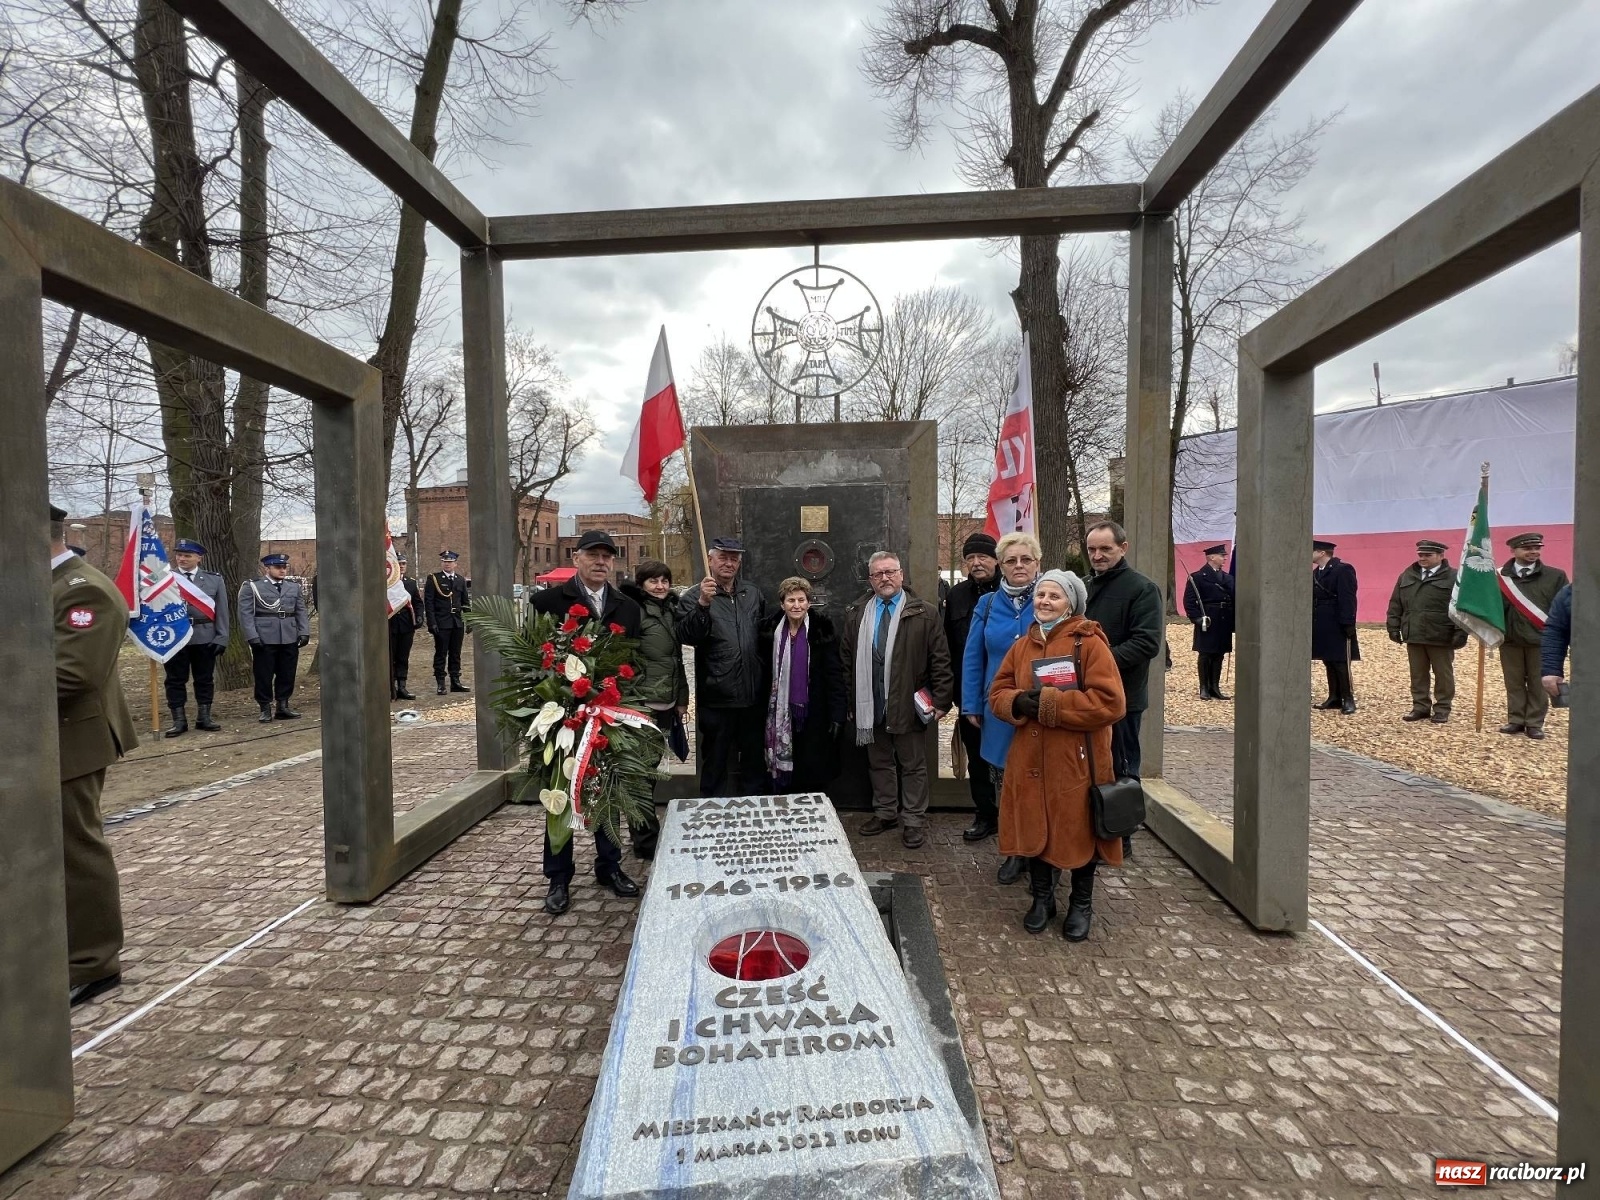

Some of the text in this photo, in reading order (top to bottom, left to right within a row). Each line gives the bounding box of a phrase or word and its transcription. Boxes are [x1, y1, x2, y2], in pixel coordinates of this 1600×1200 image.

[677, 795, 823, 812] PAMIĘCI
[681, 815, 827, 831] WYKLĘTYCH
[689, 808, 818, 822] ŻOŁNIERZY
[680, 839, 839, 854] REPRESJONOWANYCH
[715, 855, 799, 867] WIĘZIENIU
[741, 865, 794, 875] LATACH
[714, 975, 829, 1009] CZEŚĆ
[667, 1002, 879, 1042] I CHWAŁA
[653, 1025, 894, 1068] BOHATEROM!
[633, 1094, 935, 1142] MIESZKAŃCY RACIBORZA
[676, 1124, 902, 1165] 1 MARCA 2022 ROKU
